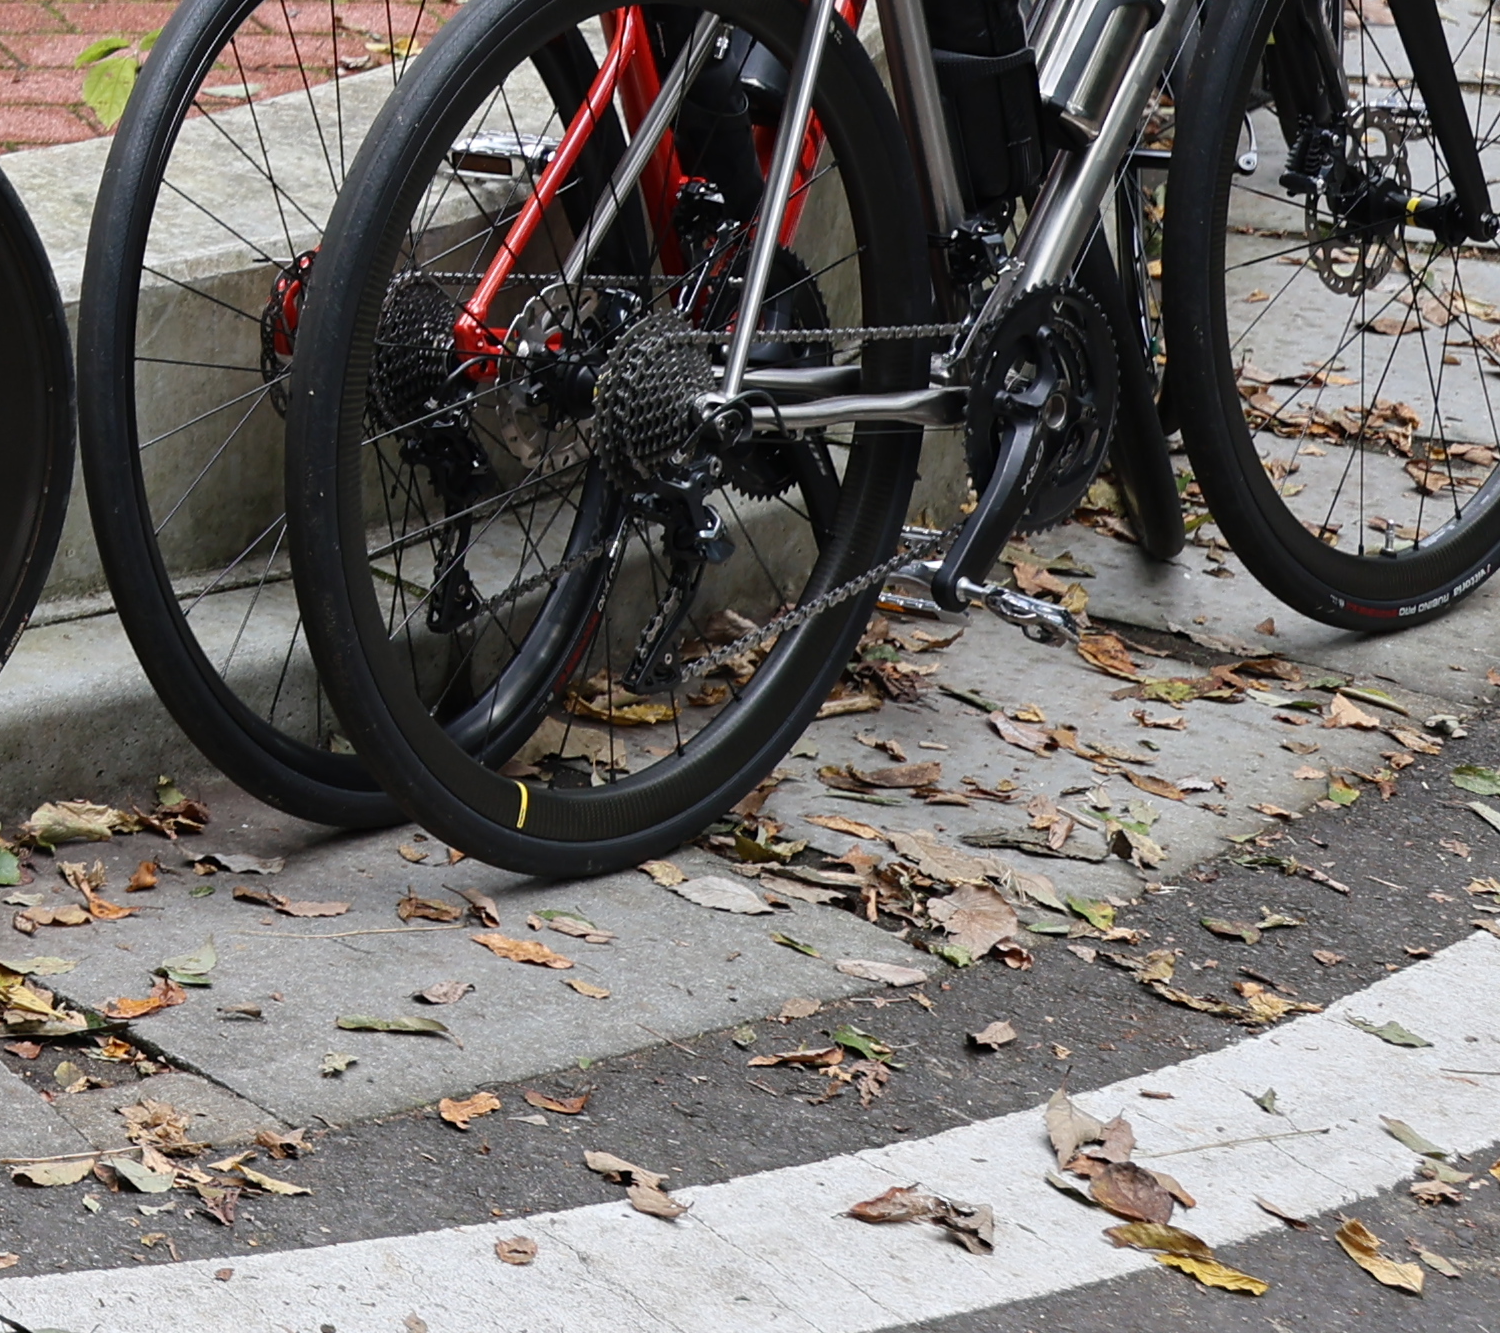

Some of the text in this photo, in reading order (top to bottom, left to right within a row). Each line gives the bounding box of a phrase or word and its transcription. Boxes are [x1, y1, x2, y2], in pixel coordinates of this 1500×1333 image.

[1452, 567, 1488, 596] vittoria
[1398, 603, 1417, 618] PRO
[1417, 591, 1450, 612] RUBINO
